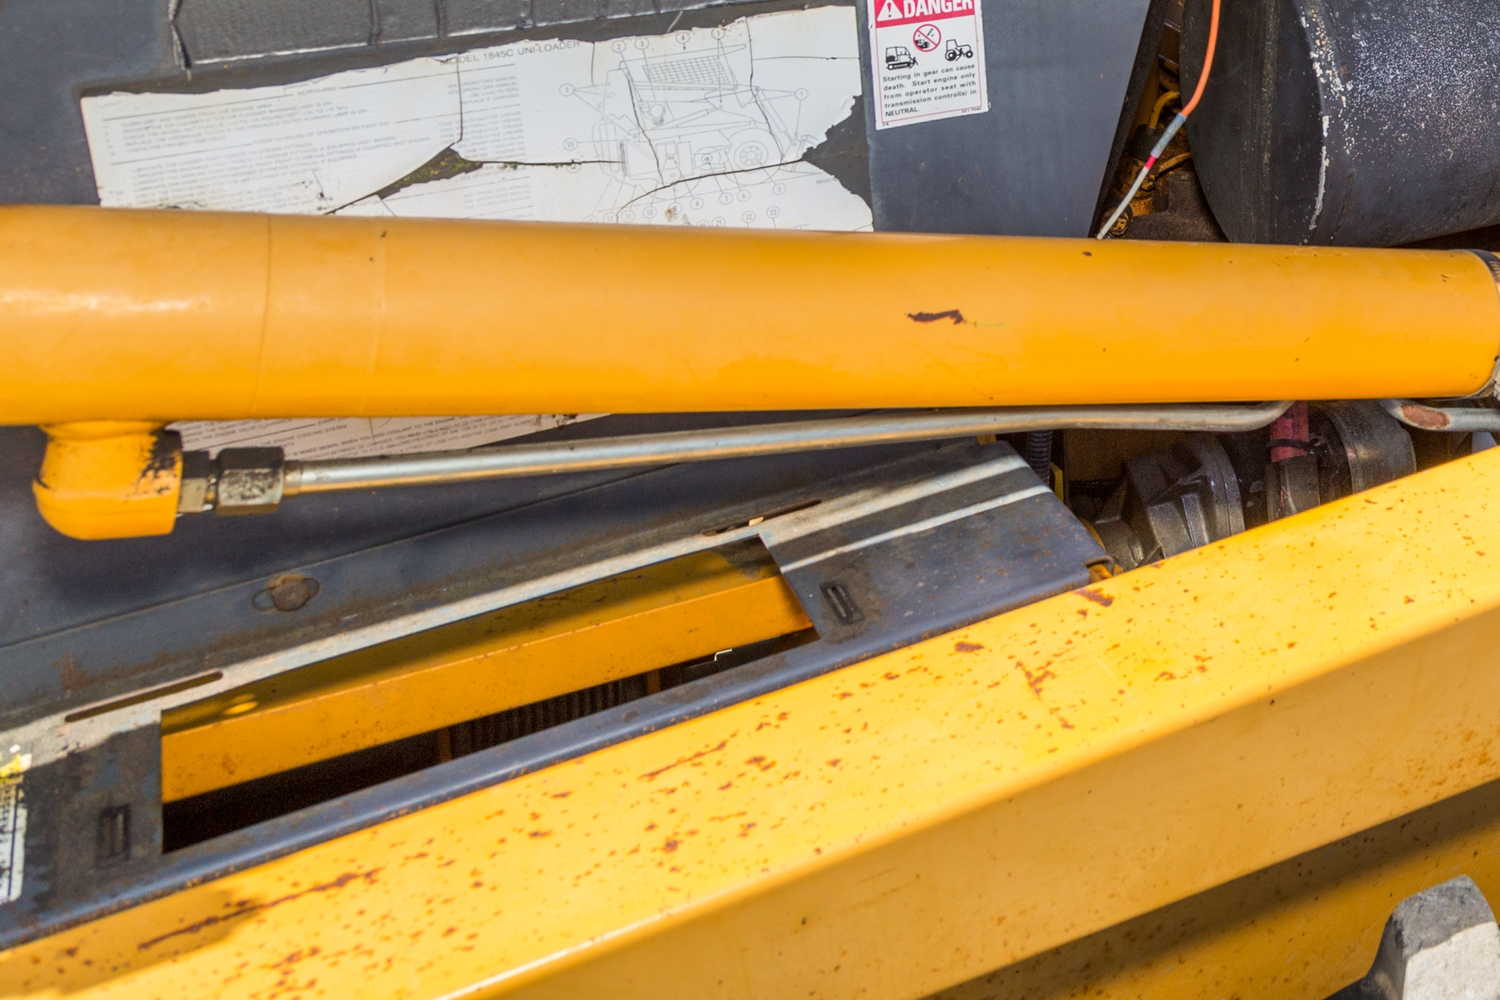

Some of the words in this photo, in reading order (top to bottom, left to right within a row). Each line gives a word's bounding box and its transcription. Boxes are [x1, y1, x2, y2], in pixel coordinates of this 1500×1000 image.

[484, 49, 514, 60] 1845C
[517, 40, 580, 55] UNI-LOADER
[882, 73, 911, 82] Starting
[923, 69, 938, 77] gear
[883, 83, 906, 91] death.
[933, 75, 957, 83] engine
[904, 86, 937, 96] operator
[941, 83, 956, 91] seat
[884, 96, 931, 108] transmission
[934, 89, 967, 100] control(s)
